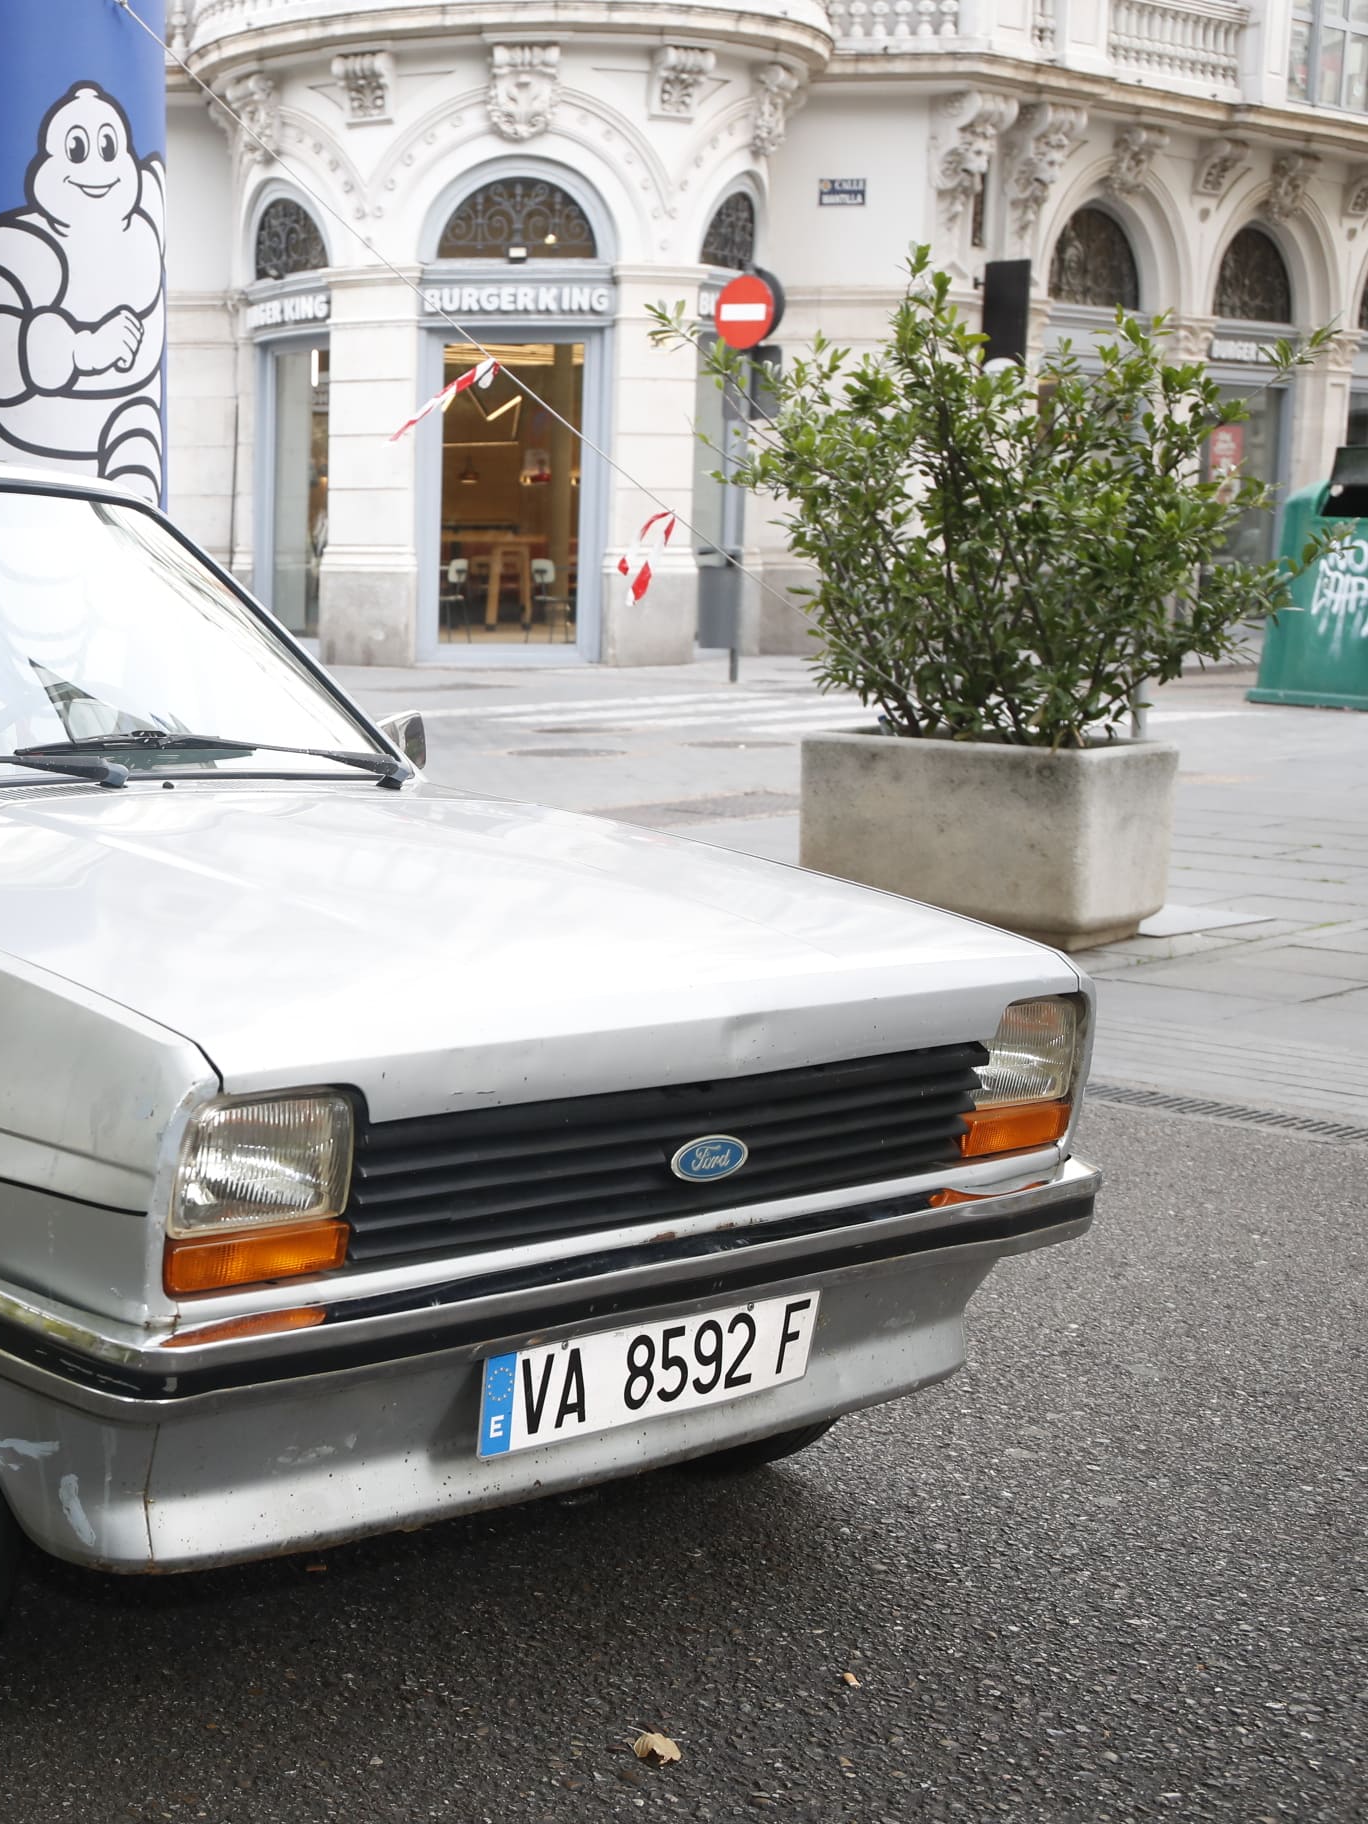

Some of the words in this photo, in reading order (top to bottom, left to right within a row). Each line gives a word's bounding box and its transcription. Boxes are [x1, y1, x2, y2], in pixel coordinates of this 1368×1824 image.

[691, 1144, 731, 1171] Ford
[522, 1347, 586, 1435] VA
[623, 1312, 757, 1410] 8592
[775, 1298, 811, 1374] F
[489, 1414, 505, 1438] E
